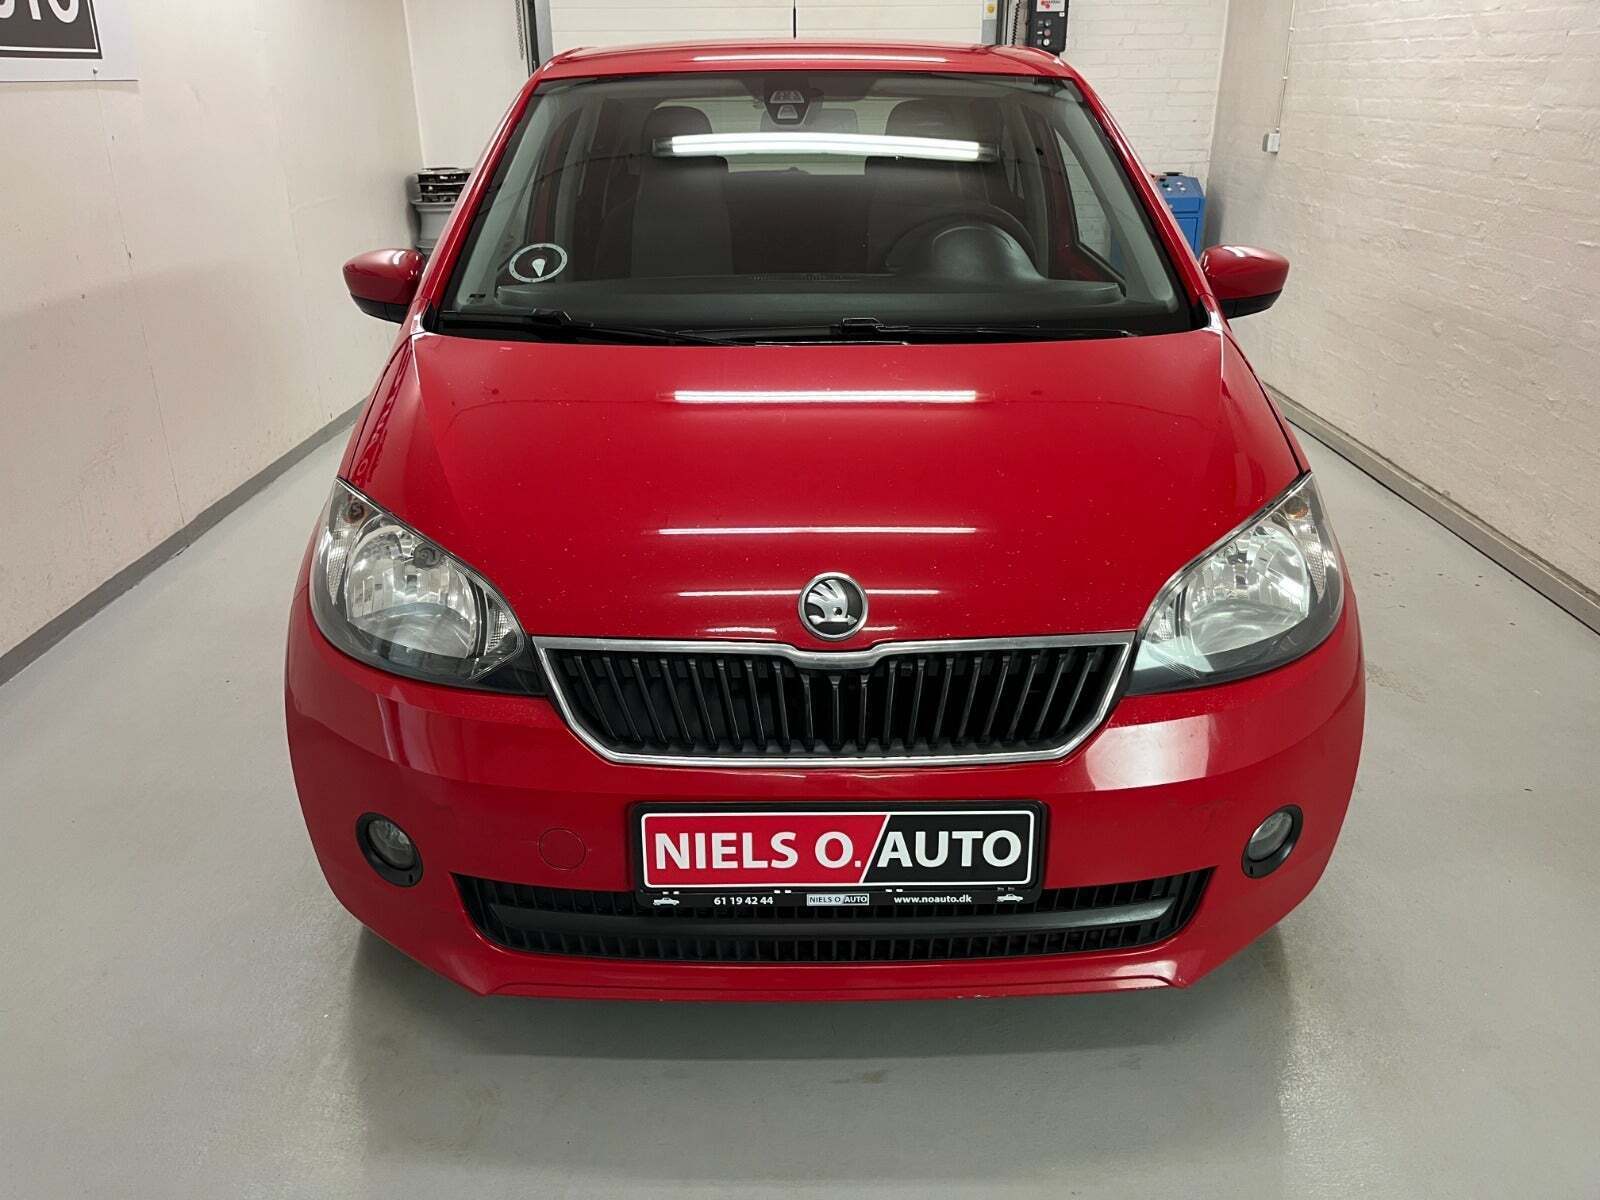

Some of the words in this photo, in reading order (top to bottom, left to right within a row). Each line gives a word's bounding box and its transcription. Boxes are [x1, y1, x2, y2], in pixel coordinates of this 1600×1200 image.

[655, 832, 798, 869] NIELS
[814, 831, 861, 868] O.
[877, 830, 1022, 867] AUTO
[714, 897, 726, 905] 61
[730, 897, 743, 905] 19
[745, 896, 757, 905] 42
[760, 896, 773, 905] 44
[809, 896, 832, 904] NIELS
[844, 896, 867, 904] AUTO
[894, 895, 972, 904] www.noauto.dk
